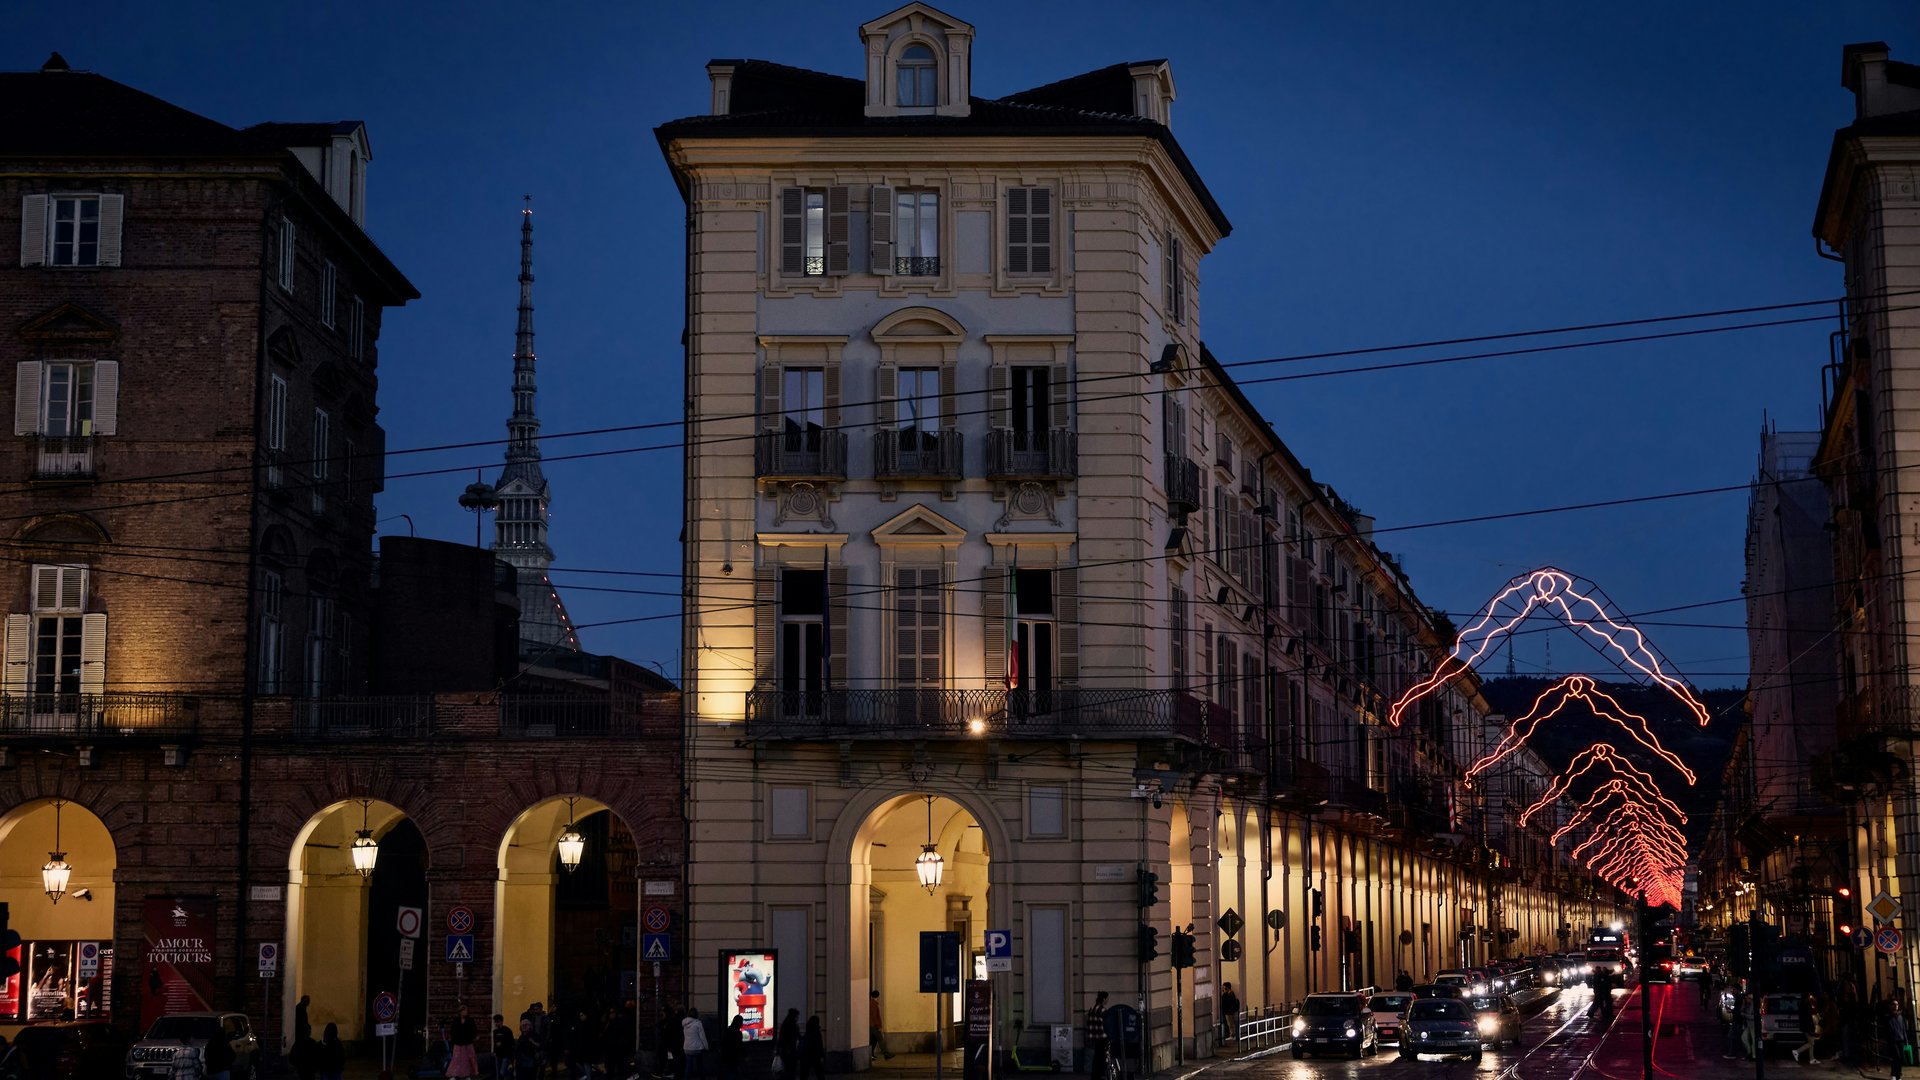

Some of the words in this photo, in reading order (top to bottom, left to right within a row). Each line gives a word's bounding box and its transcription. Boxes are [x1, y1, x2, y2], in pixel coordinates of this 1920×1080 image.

[156, 938, 204, 948] AMOUR
[990, 933, 1006, 955] P
[147, 952, 212, 964] TOUJOURS
